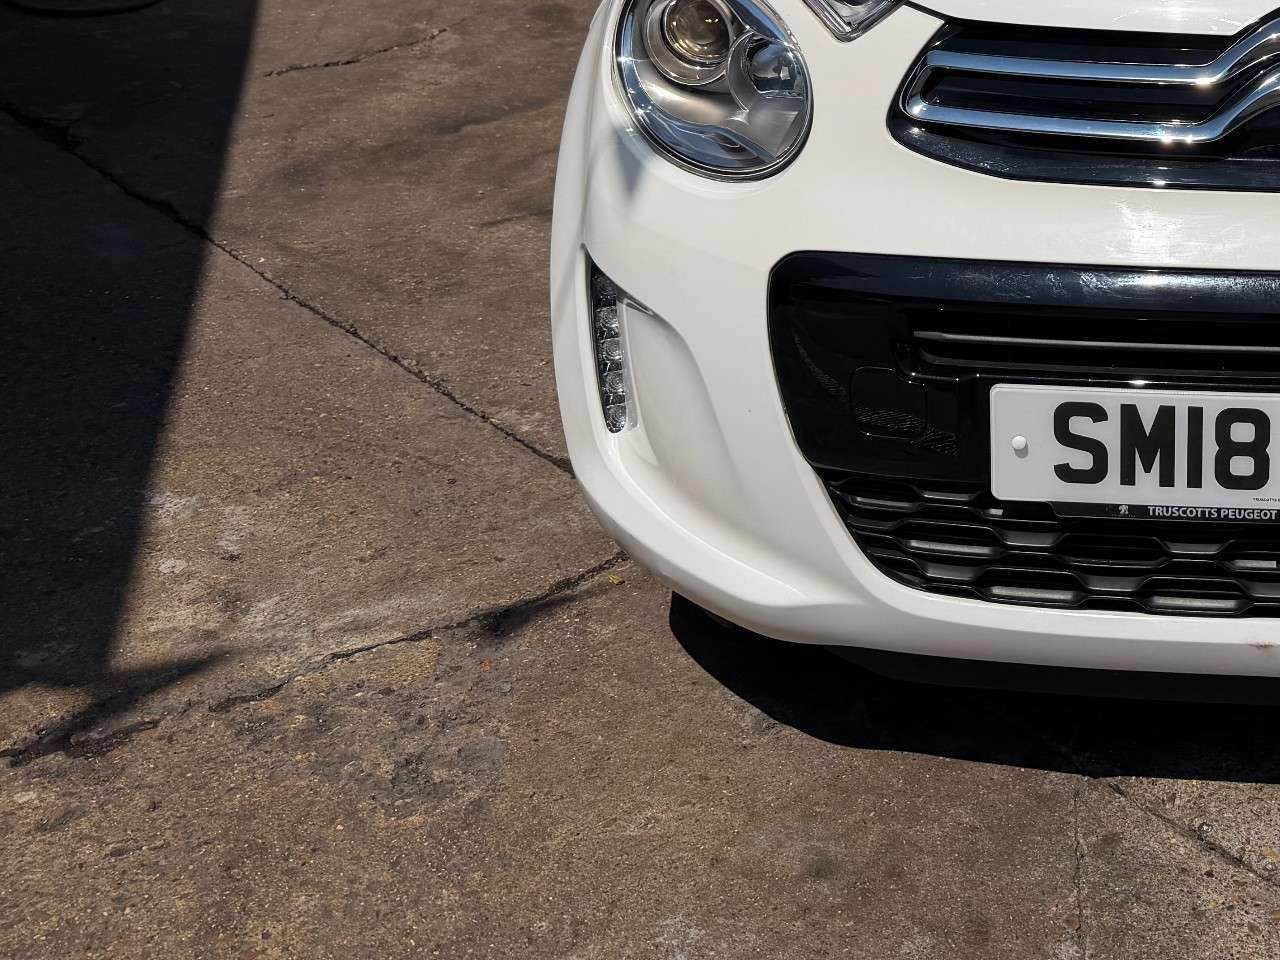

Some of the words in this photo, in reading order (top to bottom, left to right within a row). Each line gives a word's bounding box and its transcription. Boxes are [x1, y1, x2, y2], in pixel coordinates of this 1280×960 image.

[1053, 401, 1271, 491] SM18
[1147, 505, 1218, 518] TRUSCOTTS
[1220, 508, 1278, 520] PEUGEOT
